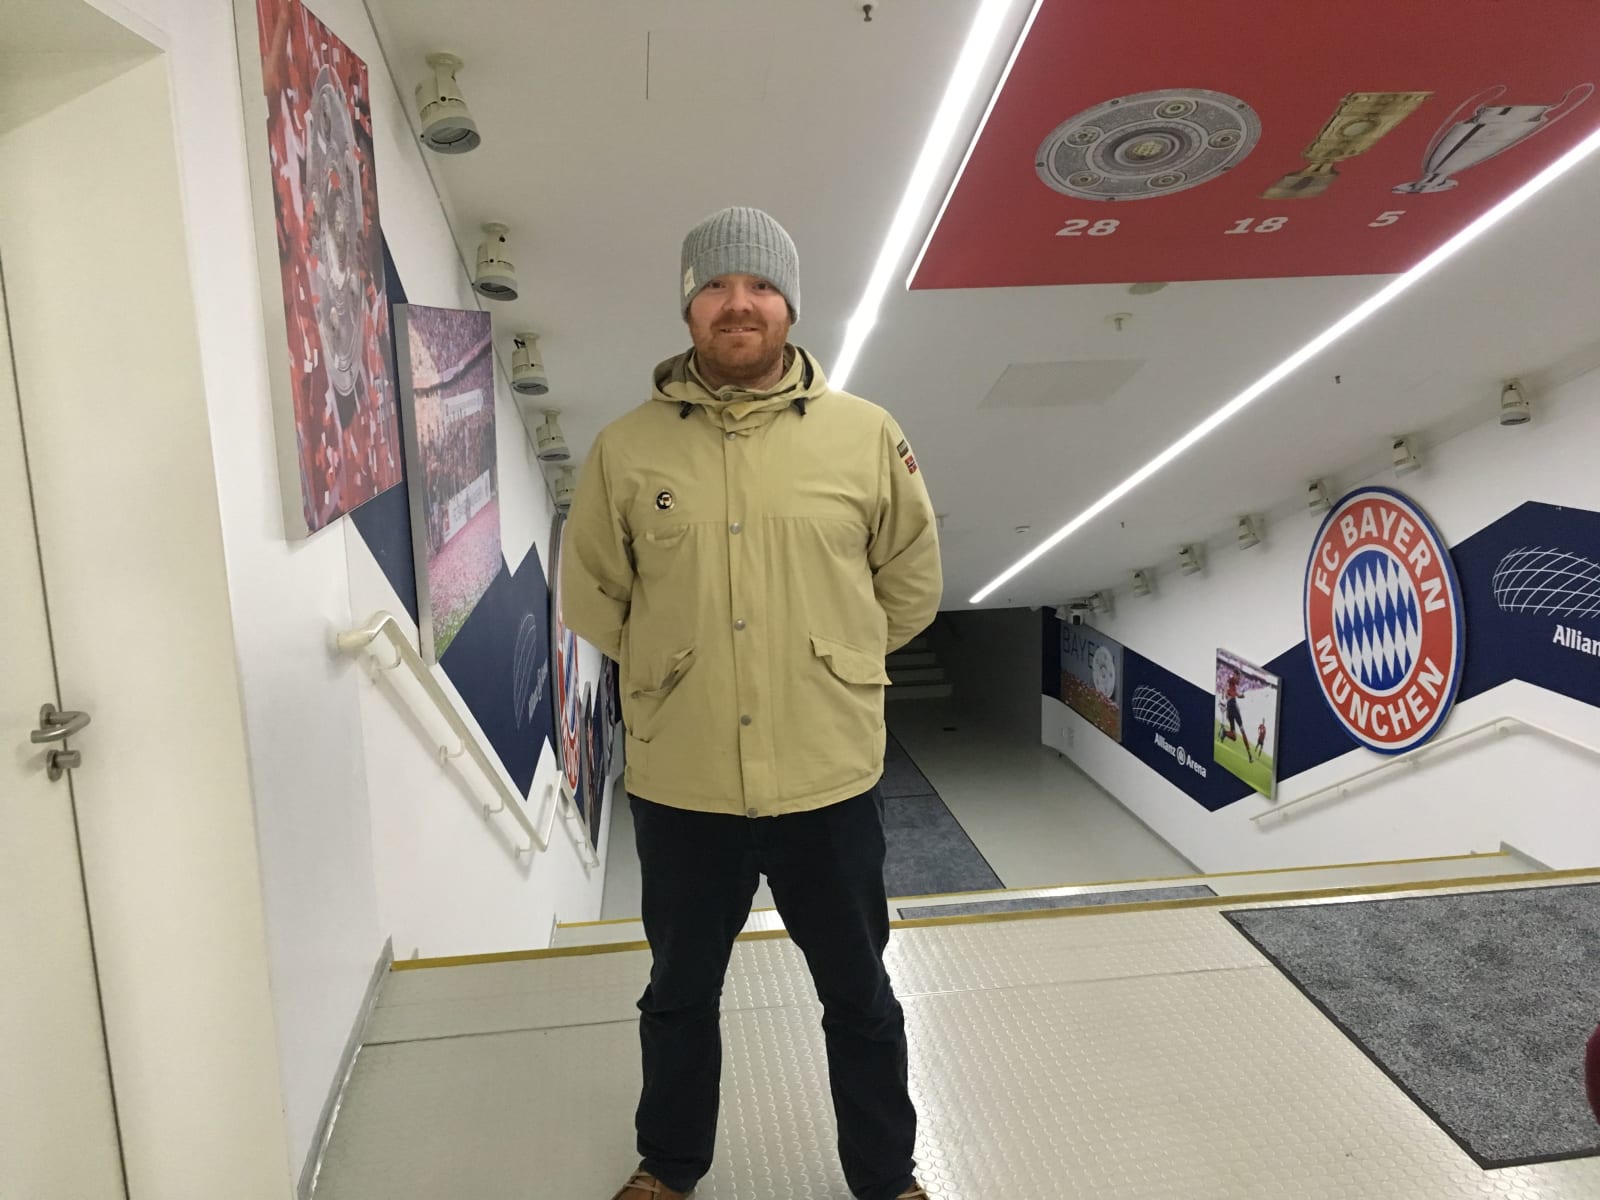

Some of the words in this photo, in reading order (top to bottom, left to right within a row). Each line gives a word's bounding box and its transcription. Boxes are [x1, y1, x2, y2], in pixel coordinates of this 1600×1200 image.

[1055, 218, 1121, 237] 28
[1223, 216, 1289, 235] 18
[1368, 210, 1406, 228] 5
[1314, 541, 1340, 596] FC
[1339, 506, 1447, 614] BAYERN
[1316, 634, 1445, 737] MÜNCHEN
[1154, 732, 1176, 757] Allianz
[1186, 754, 1207, 778] Arena
